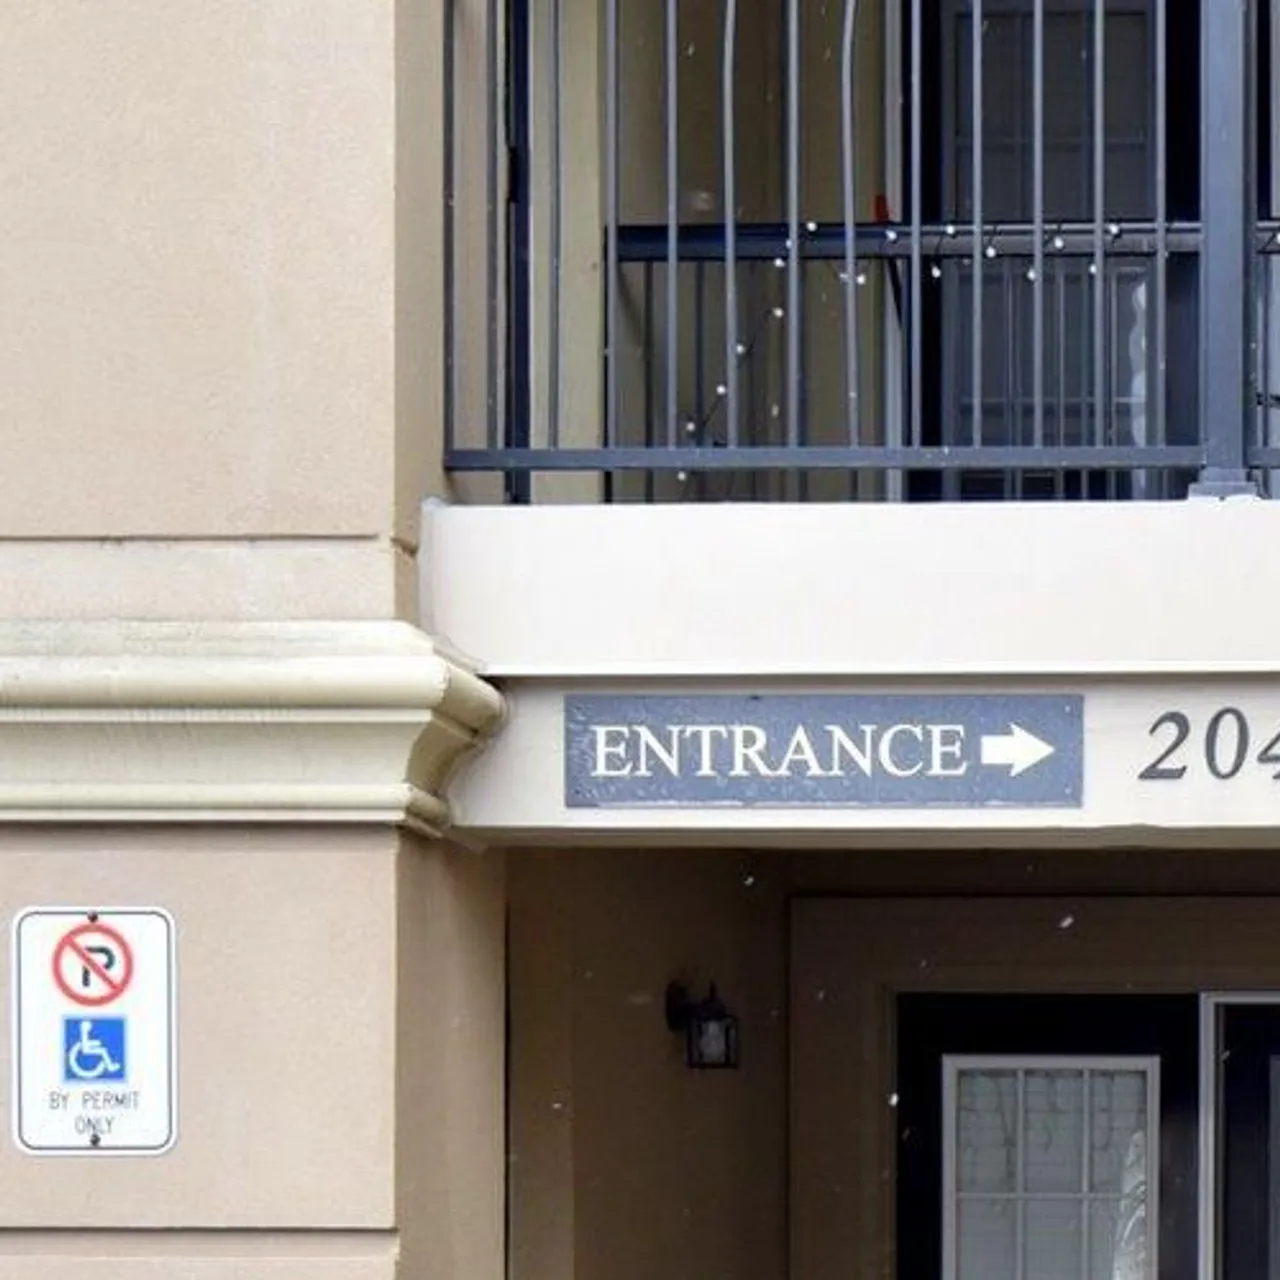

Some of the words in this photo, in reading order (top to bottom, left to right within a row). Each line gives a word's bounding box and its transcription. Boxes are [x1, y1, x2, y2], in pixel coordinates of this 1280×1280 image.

[589, 721, 968, 778] ENTRANCE
[49, 1091, 69, 1110] BY
[82, 1091, 139, 1110] PERMIT
[75, 1117, 115, 1135] ONLY
